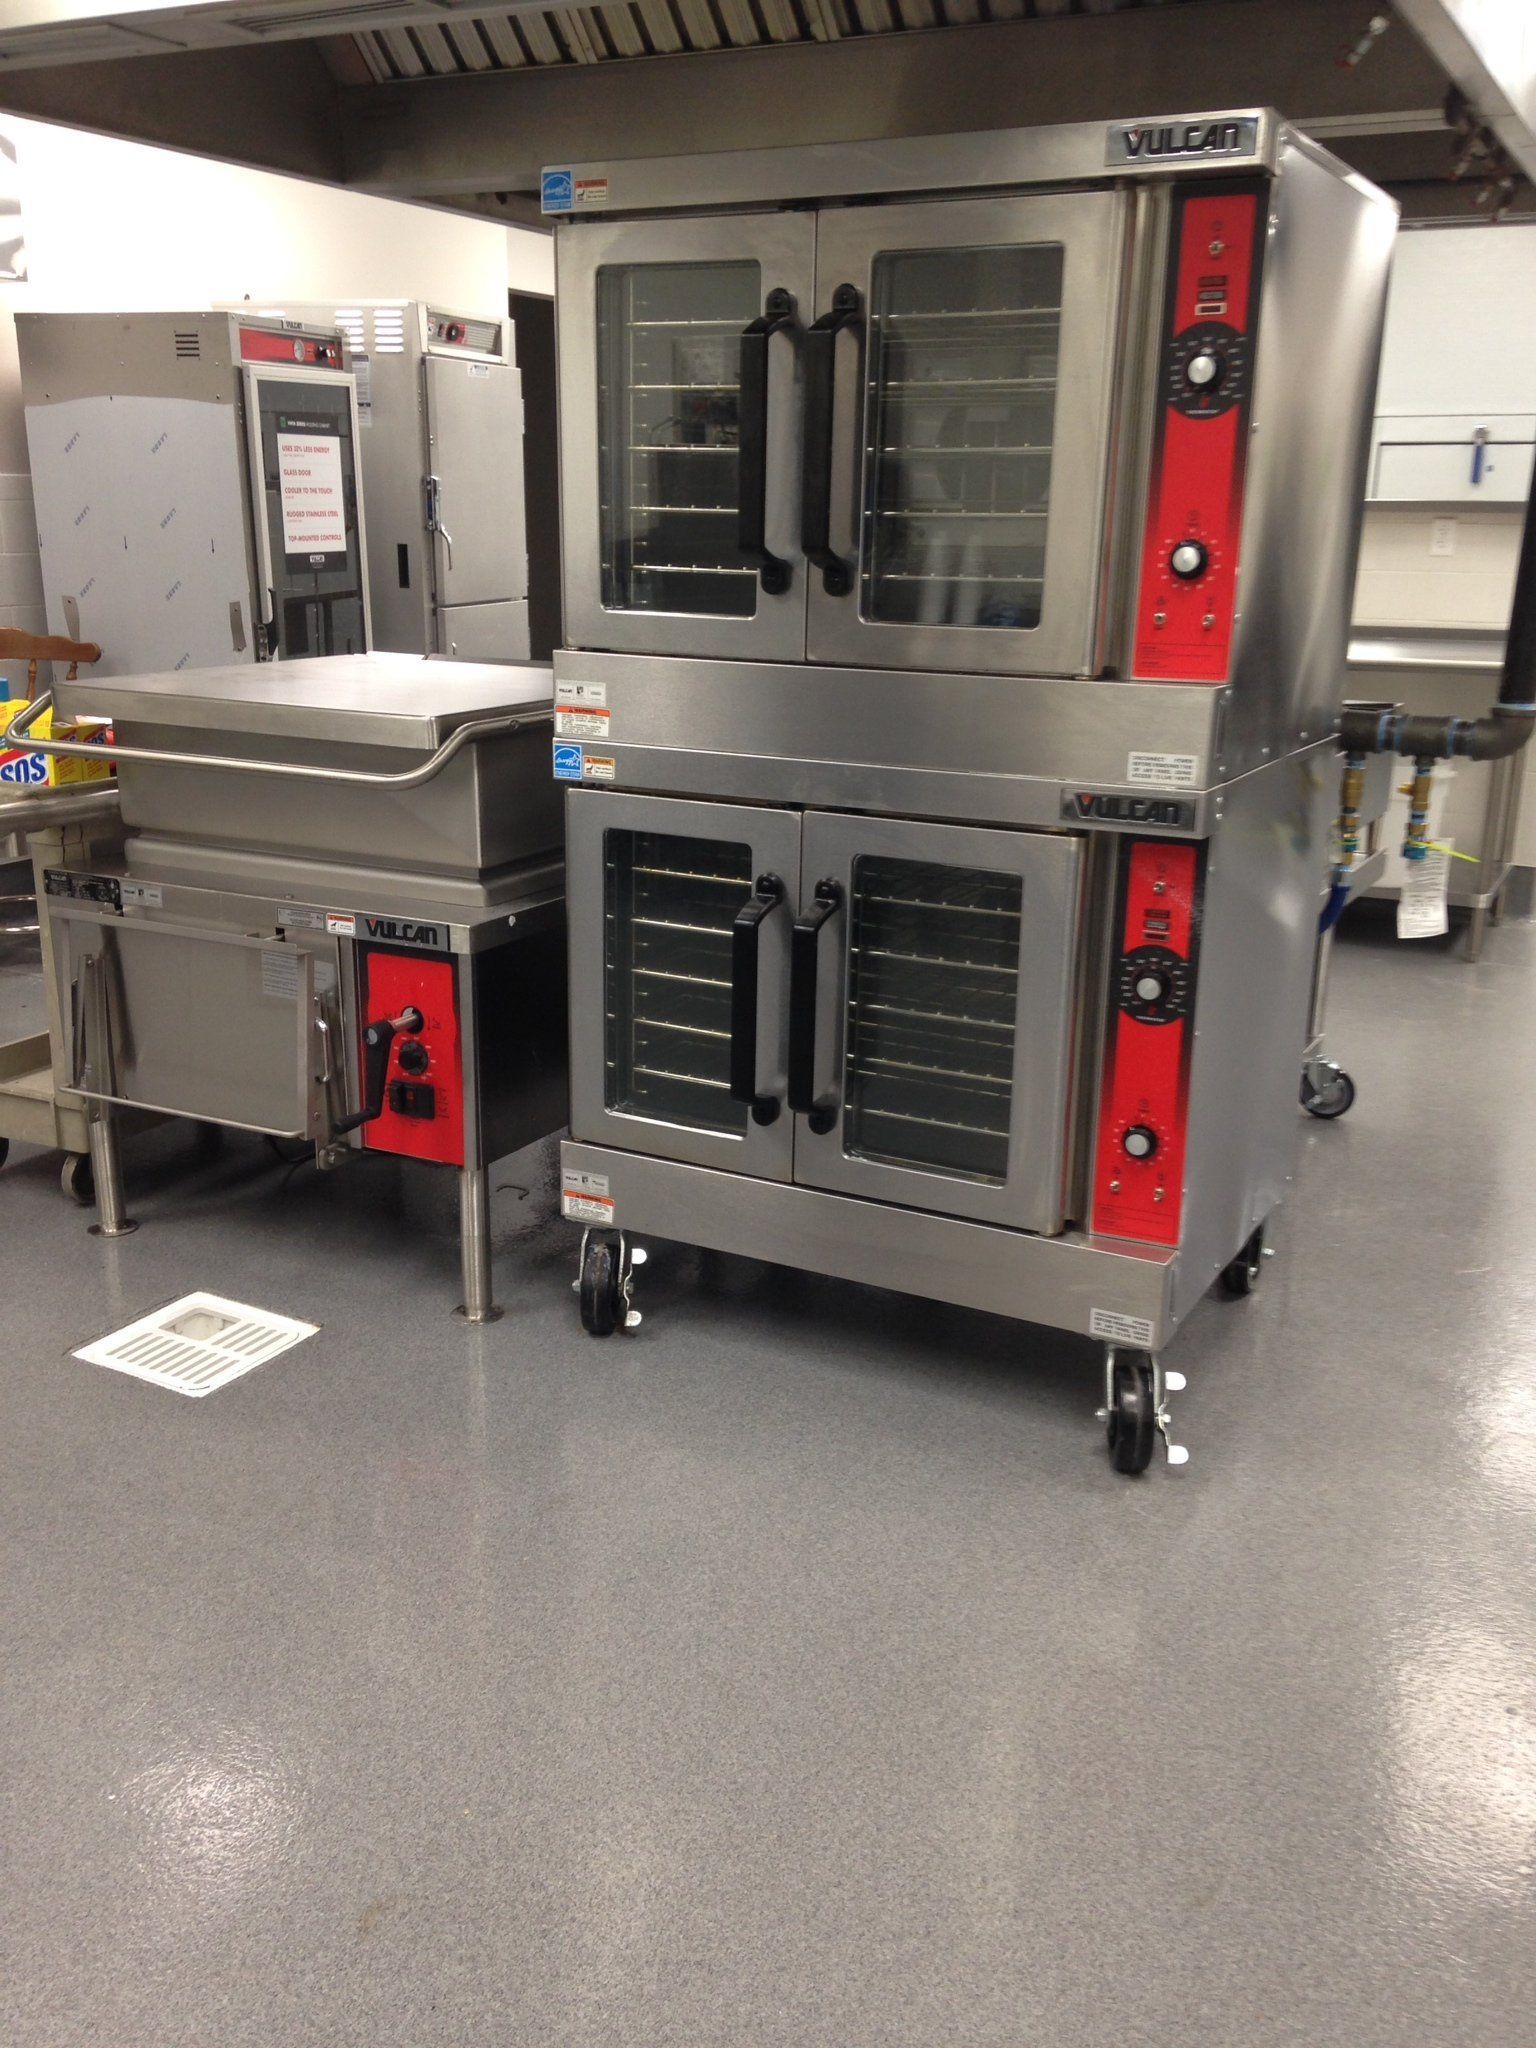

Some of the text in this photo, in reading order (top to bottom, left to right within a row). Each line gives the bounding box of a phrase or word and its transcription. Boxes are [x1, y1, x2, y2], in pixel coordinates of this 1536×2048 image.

[1123, 124, 1241, 158] VULCAN
[286, 510, 339, 518] RUGGED STAINLESS STEEL
[288, 534, 319, 542] TOP-MOUNTED
[1074, 793, 1180, 826] VULCAN
[365, 917, 438, 946] VULCAN
